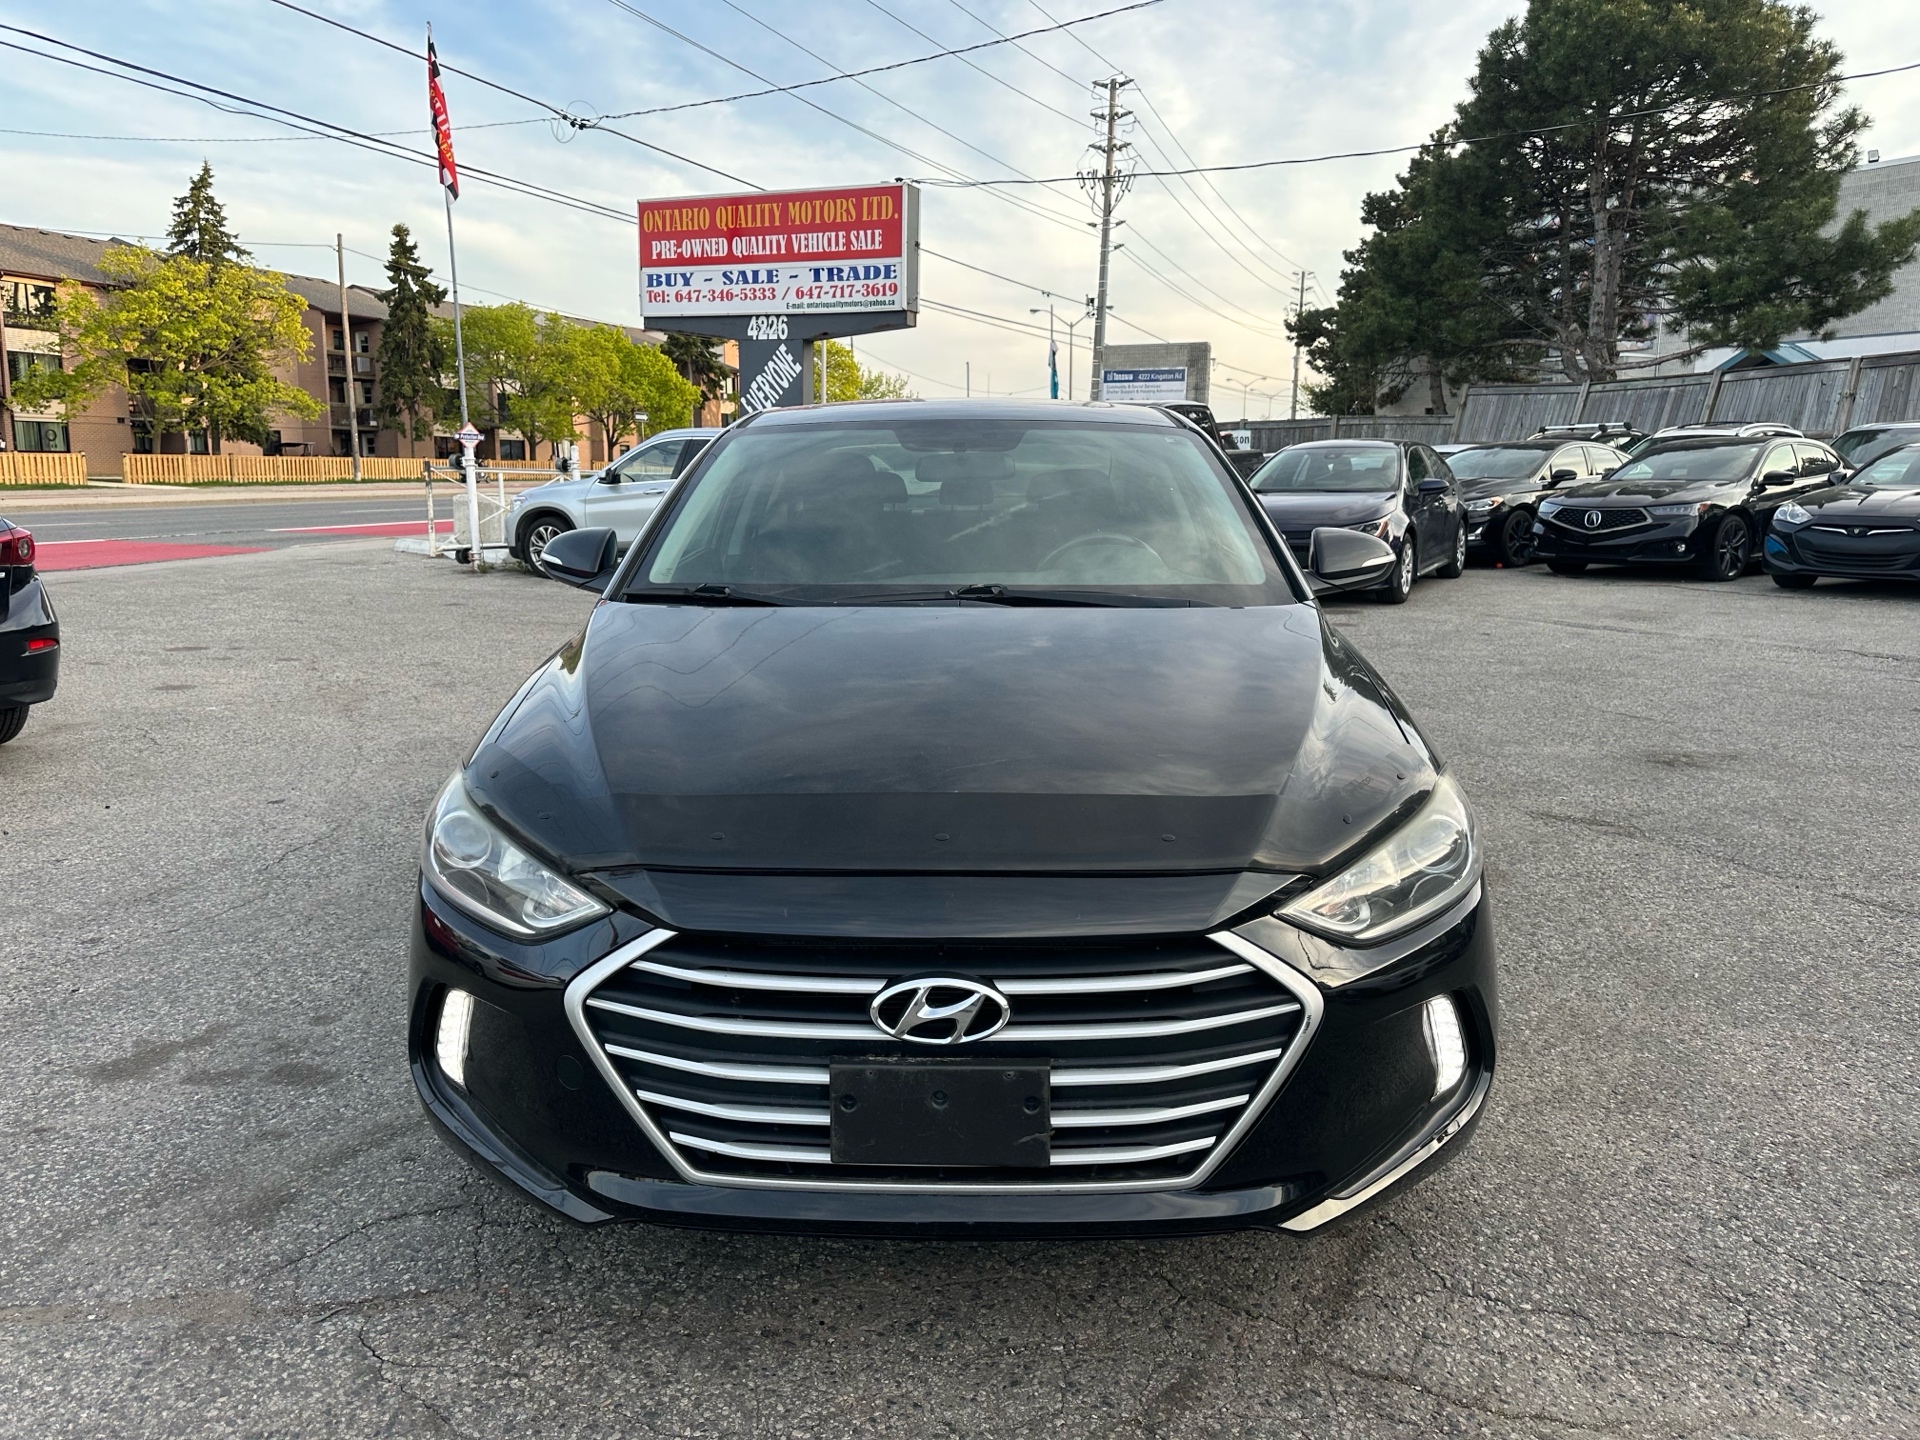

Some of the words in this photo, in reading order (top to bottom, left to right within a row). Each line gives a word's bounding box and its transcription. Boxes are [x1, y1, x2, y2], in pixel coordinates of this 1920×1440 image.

[643, 207, 710, 233] ONTARIO
[716, 202, 782, 231] QUALITY
[788, 197, 856, 226] MOTORS
[861, 195, 899, 222] LTD.
[651, 238, 728, 260] PRE-OWNED
[732, 235, 787, 258] QUALITY
[791, 231, 847, 254] VEHICLE
[850, 229, 882, 250] SALE
[646, 272, 694, 288] BUY
[722, 269, 780, 285] SALE
[809, 264, 898, 283] TRADE
[646, 289, 671, 304] Tel:
[674, 287, 777, 303] 647-346-5333
[781, 286, 791, 301] /
[795, 282, 898, 300] 647-717-3619
[786, 302, 806, 310] E-mail:
[806, 299, 895, 310] ontarioqualitymotors@yahoo.ca
[747, 315, 788, 340] 4226
